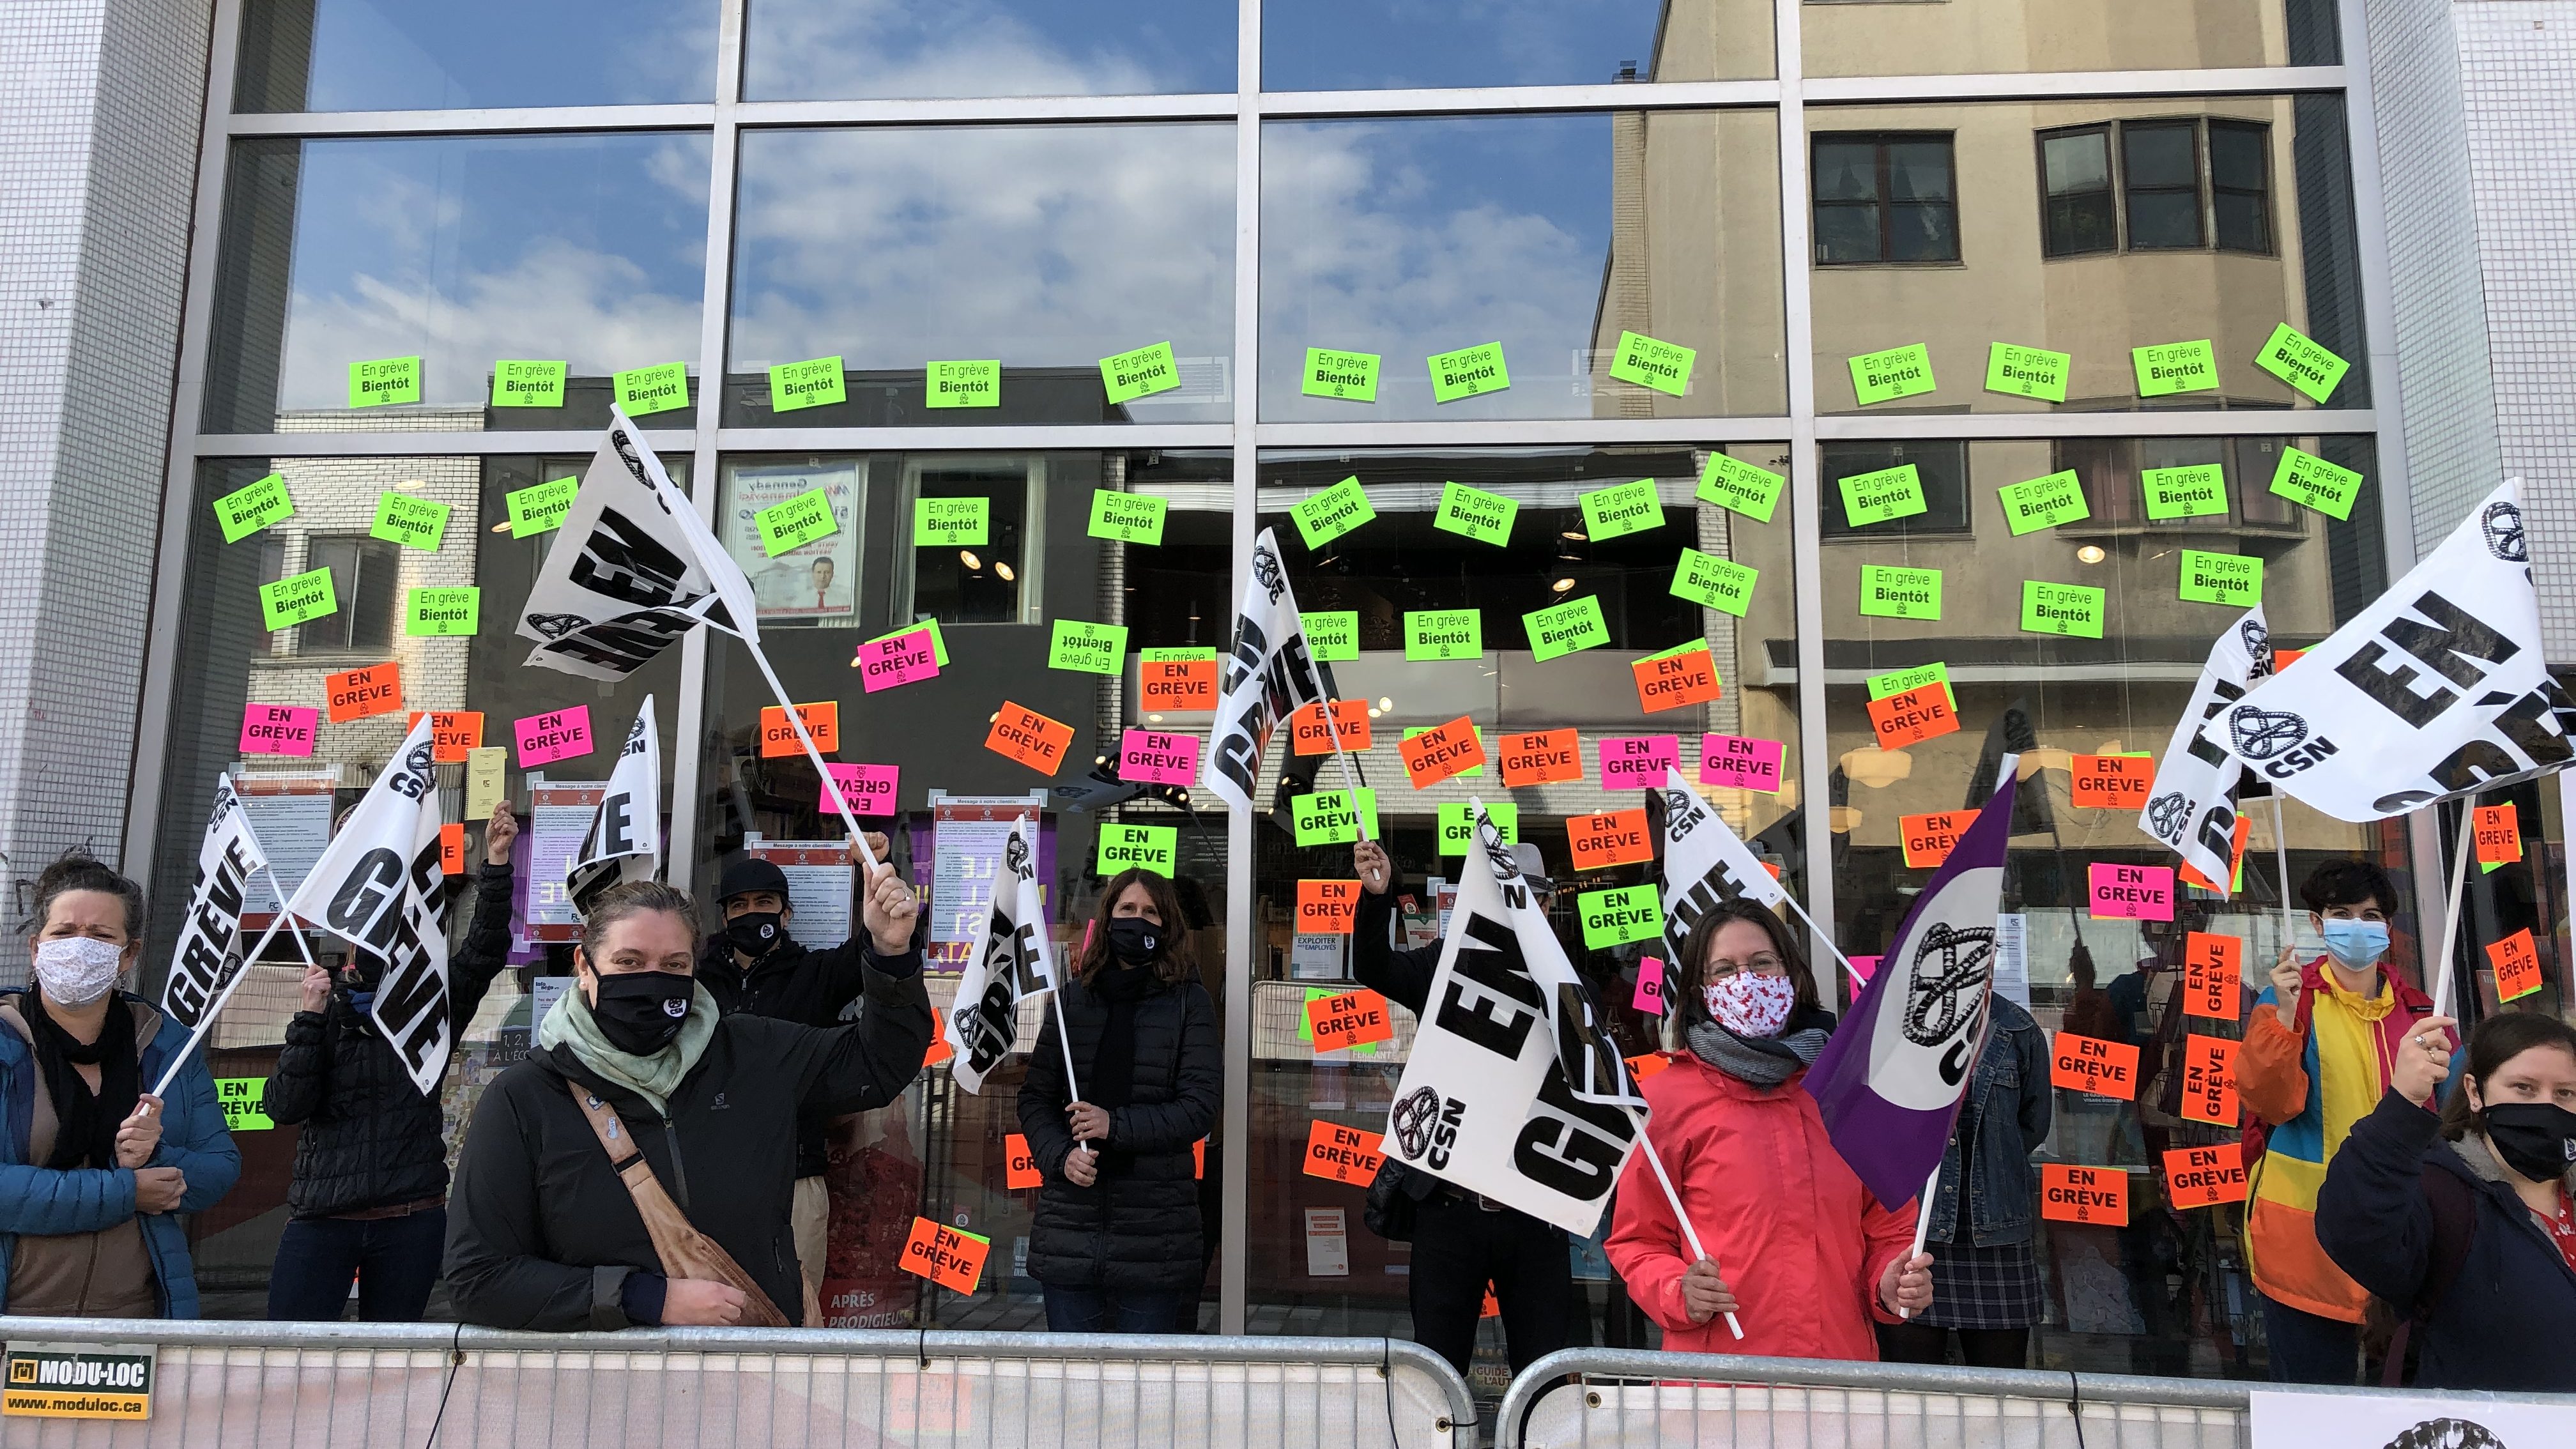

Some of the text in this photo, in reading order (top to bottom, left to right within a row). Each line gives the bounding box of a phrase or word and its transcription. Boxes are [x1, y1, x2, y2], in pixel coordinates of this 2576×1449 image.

[1112, 350, 1162, 371] En grève
[2147, 346, 2201, 363] En grève
[2284, 333, 2334, 370] En grève
[1318, 353, 1368, 370] En grève
[2150, 362, 2205, 379] Bientôt
[2274, 348, 2326, 385] Bientôt
[940, 364, 990, 379] En grève
[1117, 364, 1167, 387] Bientôt
[1315, 369, 1366, 387] Bientôt
[940, 380, 989, 393] Bientôt
[2294, 455, 2348, 486] En grève
[226, 482, 274, 510] En grève
[2288, 471, 2342, 503] Bientôt
[231, 495, 280, 525] Bientôt
[1301, 487, 1351, 517] En grève
[1455, 488, 1505, 514] En grève
[1310, 501, 1359, 532] Bientôt
[1450, 505, 1501, 530] Bientôt
[2195, 555, 2250, 574] En grève
[2194, 573, 2249, 592] Bientôt
[1315, 615, 1348, 631] grève
[1535, 605, 1588, 628] En grève
[1306, 632, 1348, 646] ientôt
[1541, 620, 1594, 645] Bientôt
[882, 638, 907, 656] EN
[1062, 636, 1113, 653] Bientôt
[868, 650, 928, 676] GRÈVE
[1060, 652, 1110, 671] En grève
[1658, 659, 1683, 675] EN
[2246, 658, 2273, 680] SN
[2334, 590, 2522, 730] EN
[348, 671, 371, 687] EN
[1165, 664, 1188, 677] EN
[1147, 679, 1208, 695] GRÈVE
[1644, 672, 1708, 696] GRÈVE
[1881, 669, 1936, 692] En grève
[333, 684, 392, 707] GRÈVE
[268, 708, 292, 722] EN
[431, 715, 454, 729] EN
[1020, 714, 1045, 733] EN
[249, 723, 307, 740] GRÈVE
[998, 724, 1055, 758] GRÈVE
[1147, 735, 1172, 750] EN
[1127, 751, 1188, 770] GRÈVE
[2097, 759, 2122, 772] EN
[2265, 735, 2340, 779] CSN
[389, 772, 426, 806] CS
[2078, 775, 2144, 792] GRÈVE
[1670, 806, 1706, 843] CSN
[1927, 816, 1952, 831] EN
[2172, 799, 2196, 847] CSN
[2487, 811, 2501, 825] EN
[1910, 834, 1962, 852] GRÈV
[2479, 826, 2513, 845] GRÈVE
[2117, 868, 2143, 884] EN
[1322, 885, 1346, 898] EN
[1604, 892, 1629, 908] EN
[2097, 885, 2165, 904] GRÈVE
[1303, 900, 1354, 917] GRÈV
[1588, 908, 1654, 929] GRÈVE
[167, 835, 258, 1029] GRÈVE
[2504, 939, 2518, 958] EN
[2189, 963, 2204, 990] EN
[2499, 954, 2534, 981] GRÈVE
[2205, 944, 2224, 1011] GRÈVE
[1330, 995, 1356, 1013] EN
[1317, 1011, 1380, 1036] GRÈVE
[2080, 1040, 2107, 1058] EN
[2058, 1056, 2126, 1082] GRÈVE
[224, 1082, 249, 1097] EN
[221, 1098, 264, 1116] RÈVE
[1334, 1128, 1361, 1147] EN
[1427, 1097, 1467, 1171] CSN
[1312, 1144, 1379, 1174] GRÈVE
[2189, 1150, 2218, 1167] EN
[2068, 1169, 2095, 1186] EN
[2174, 1168, 2243, 1189] GRÈVE
[2048, 1187, 2117, 1208] GRÈVE
[937, 1229, 962, 1250] EN
[831, 1291, 875, 1308] APRÈS
[828, 1310, 905, 1329] PRODIGIEUS
[1476, 1367, 1508, 1377] GUIDE
[1484, 1377, 1513, 1386] L'AUT
[8, 1397, 142, 1413] www.moduloc.ca
